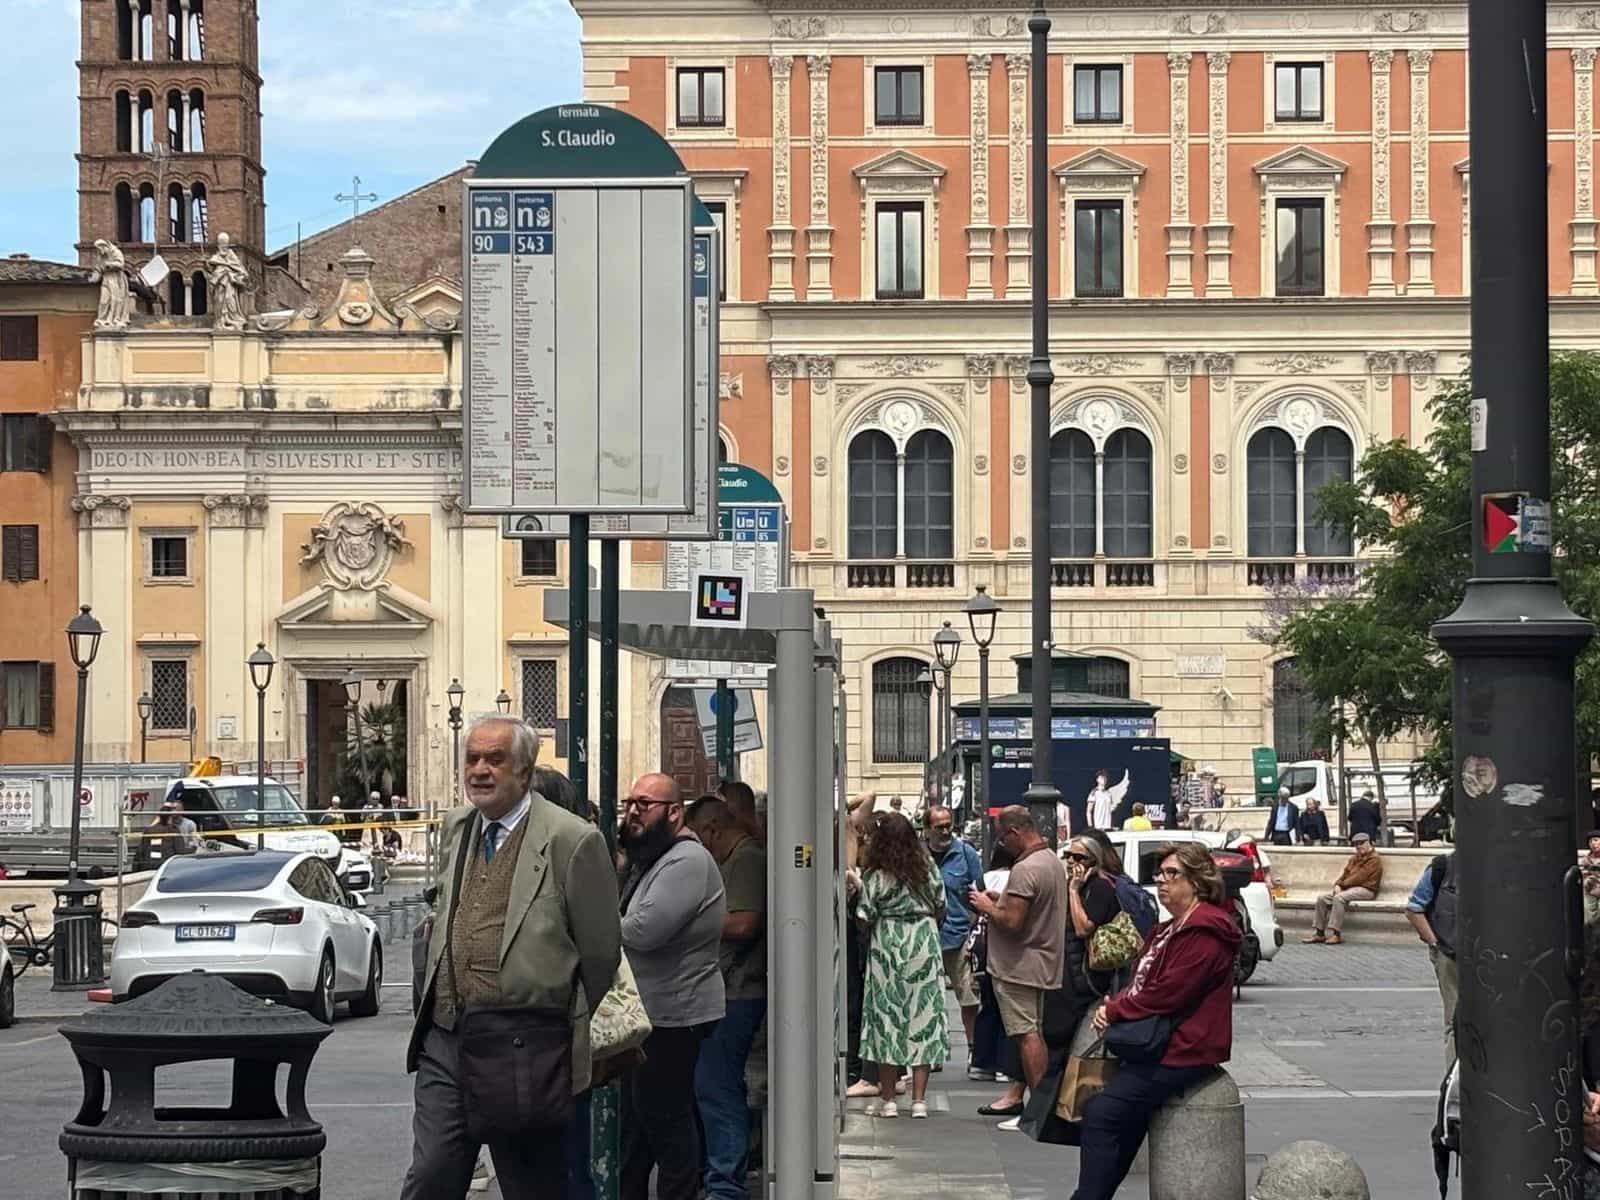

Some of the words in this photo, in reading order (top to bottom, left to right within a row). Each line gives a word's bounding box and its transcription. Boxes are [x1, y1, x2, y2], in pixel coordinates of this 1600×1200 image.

[558, 106, 599, 118] fermata
[541, 130, 555, 146] S.
[558, 129, 616, 146] Claudio
[474, 235, 494, 252] 90
[517, 235, 545, 252] 543
[94, 452, 129, 468] DEO
[135, 452, 154, 468] IN
[163, 452, 201, 468] HON
[265, 452, 366, 468] SILVESTRI
[375, 452, 400, 468] ET
